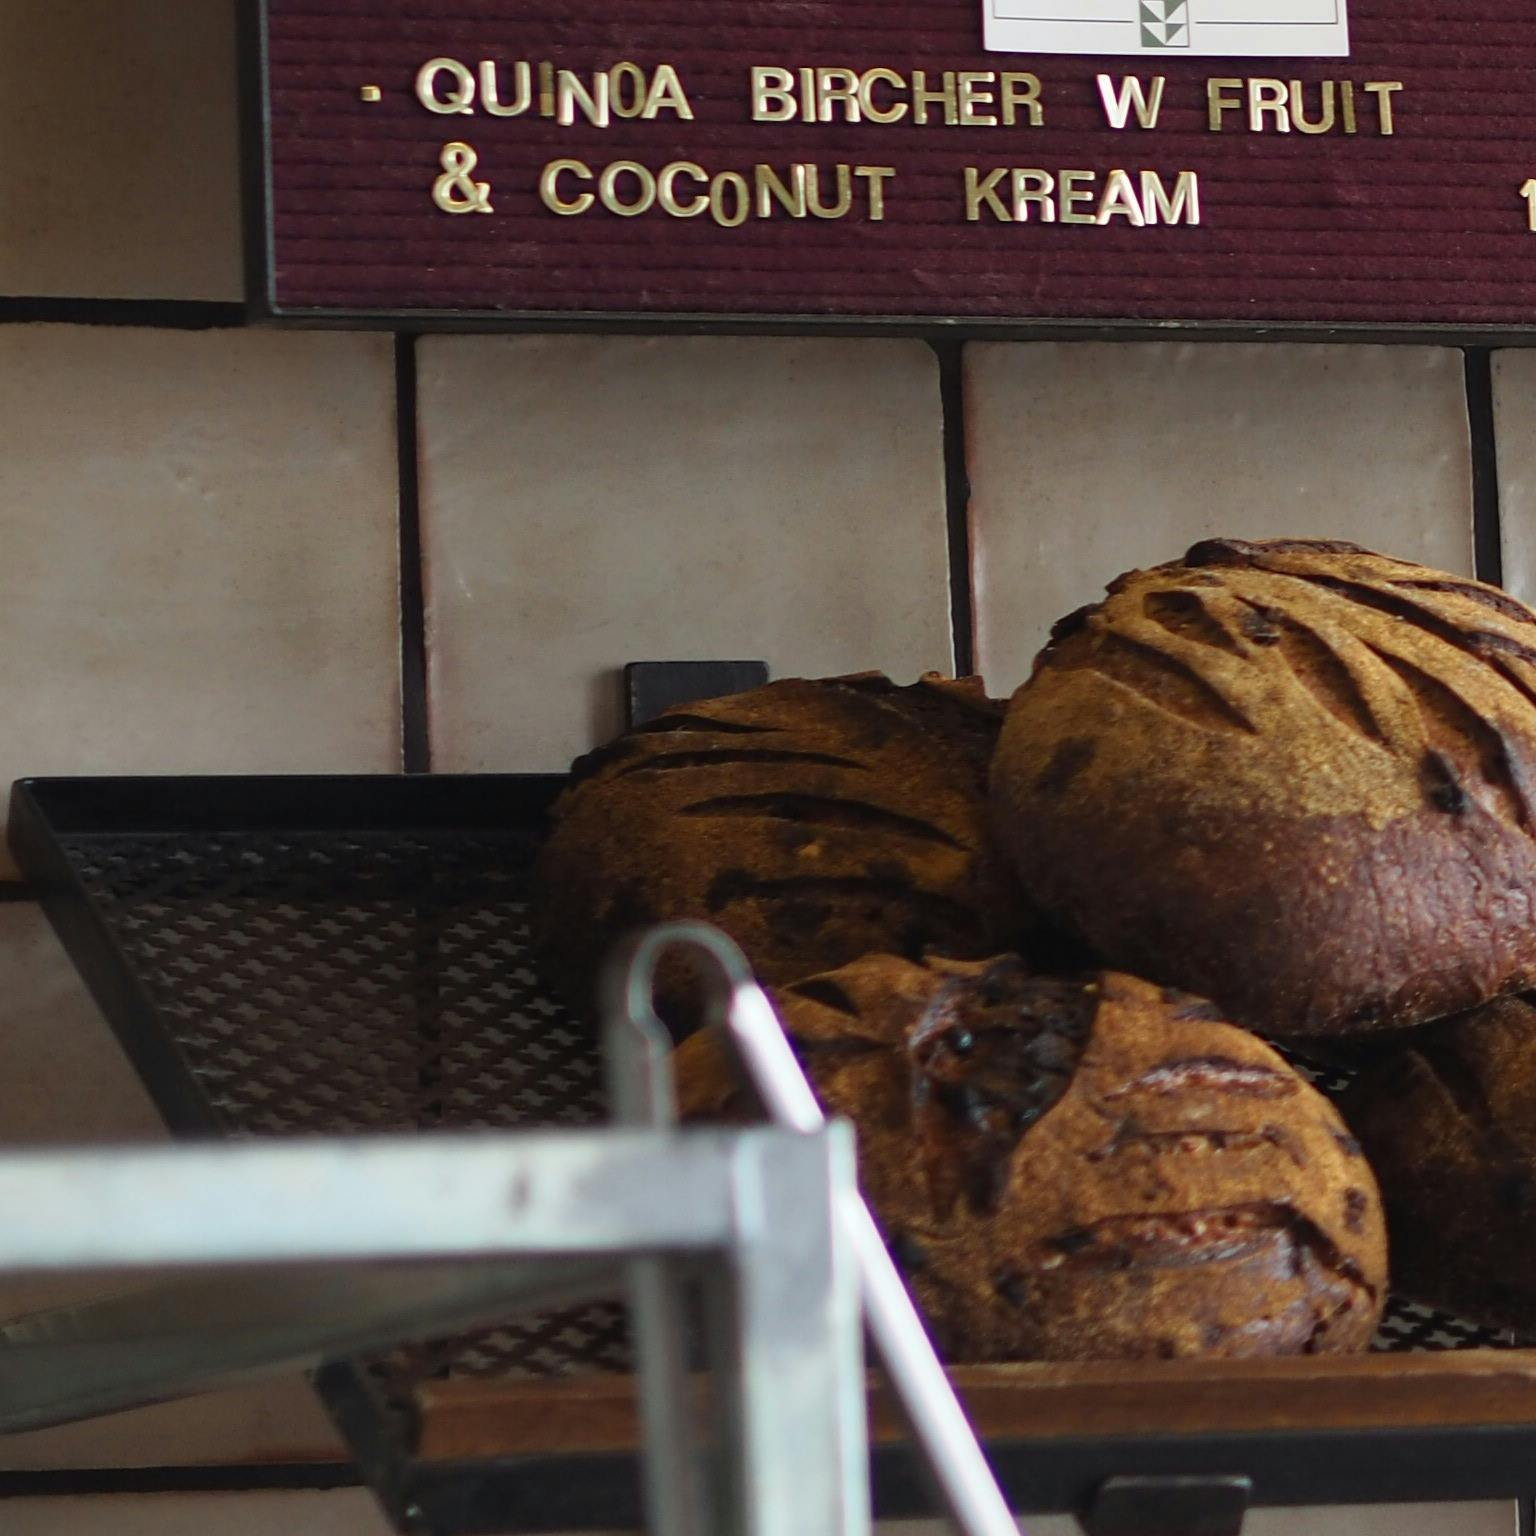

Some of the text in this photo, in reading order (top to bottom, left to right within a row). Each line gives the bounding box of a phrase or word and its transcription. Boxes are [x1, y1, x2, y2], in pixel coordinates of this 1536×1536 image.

[417, 58, 1403, 134] QUINOA BIRCHER W FRUIT
[433, 142, 1199, 227] & COCONUT KREAM
